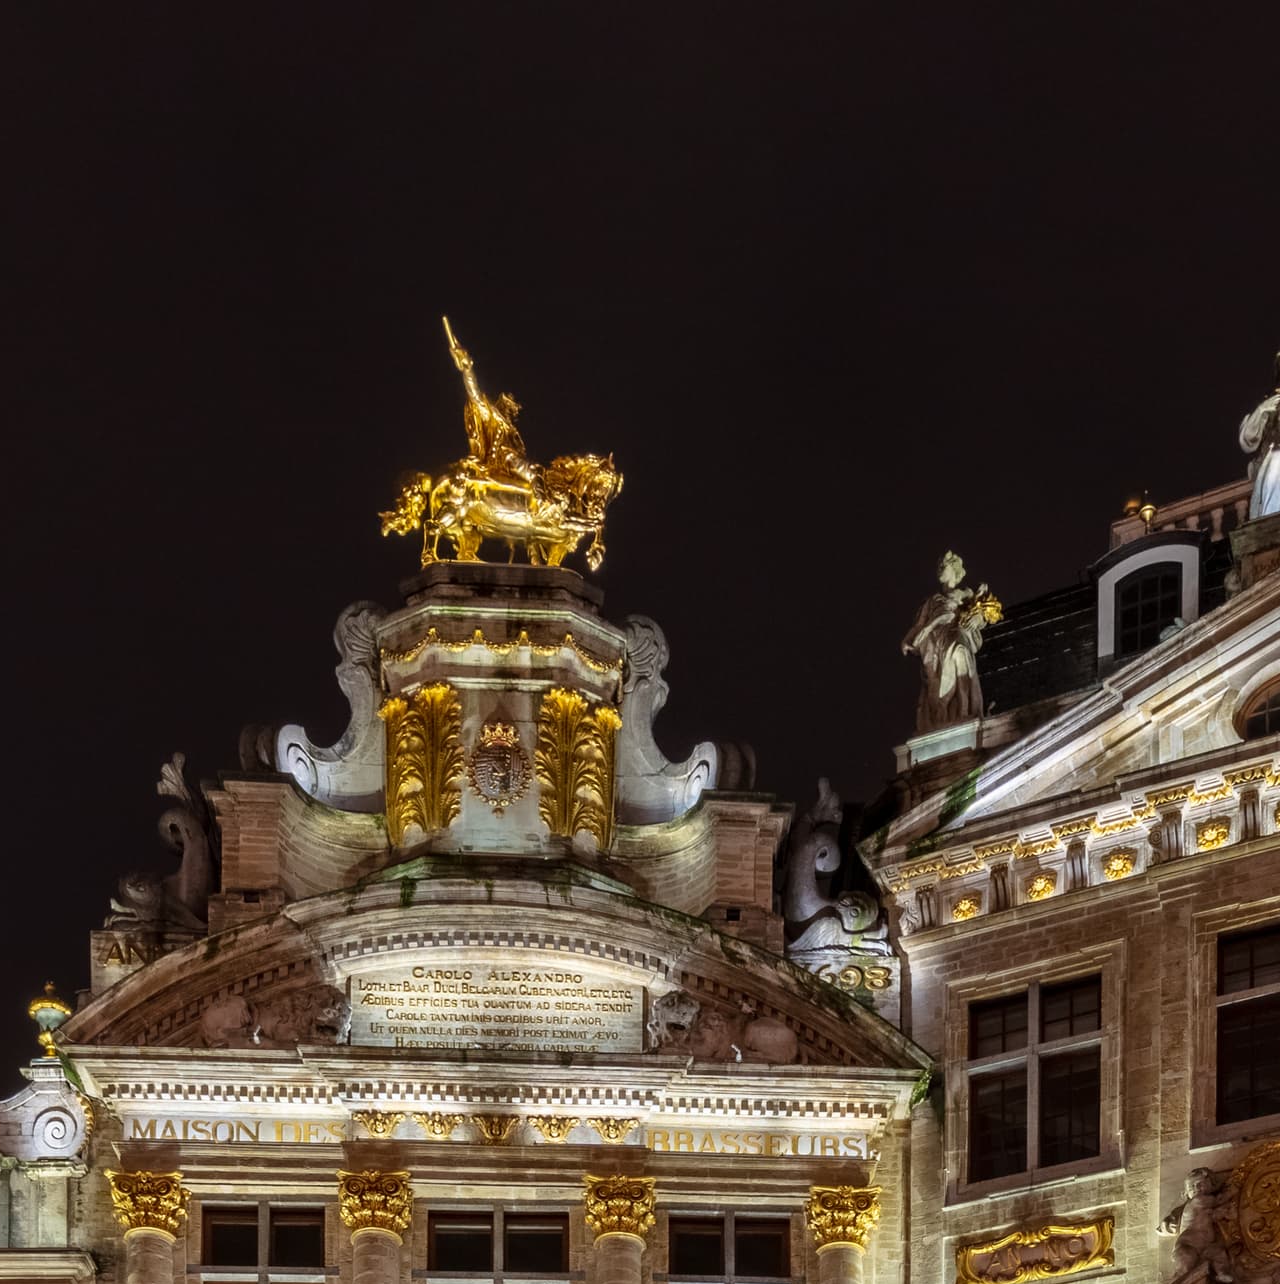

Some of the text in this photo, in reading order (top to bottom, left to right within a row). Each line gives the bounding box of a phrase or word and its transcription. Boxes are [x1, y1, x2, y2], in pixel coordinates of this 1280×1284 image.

[412, 966, 583, 983] CAROLO ALEXANDRO
[803, 963, 892, 991] 698
[536, 1001, 550, 1010] AD
[132, 1119, 348, 1143] MAISON DES
[646, 1128, 864, 1158] BRASSEURS
